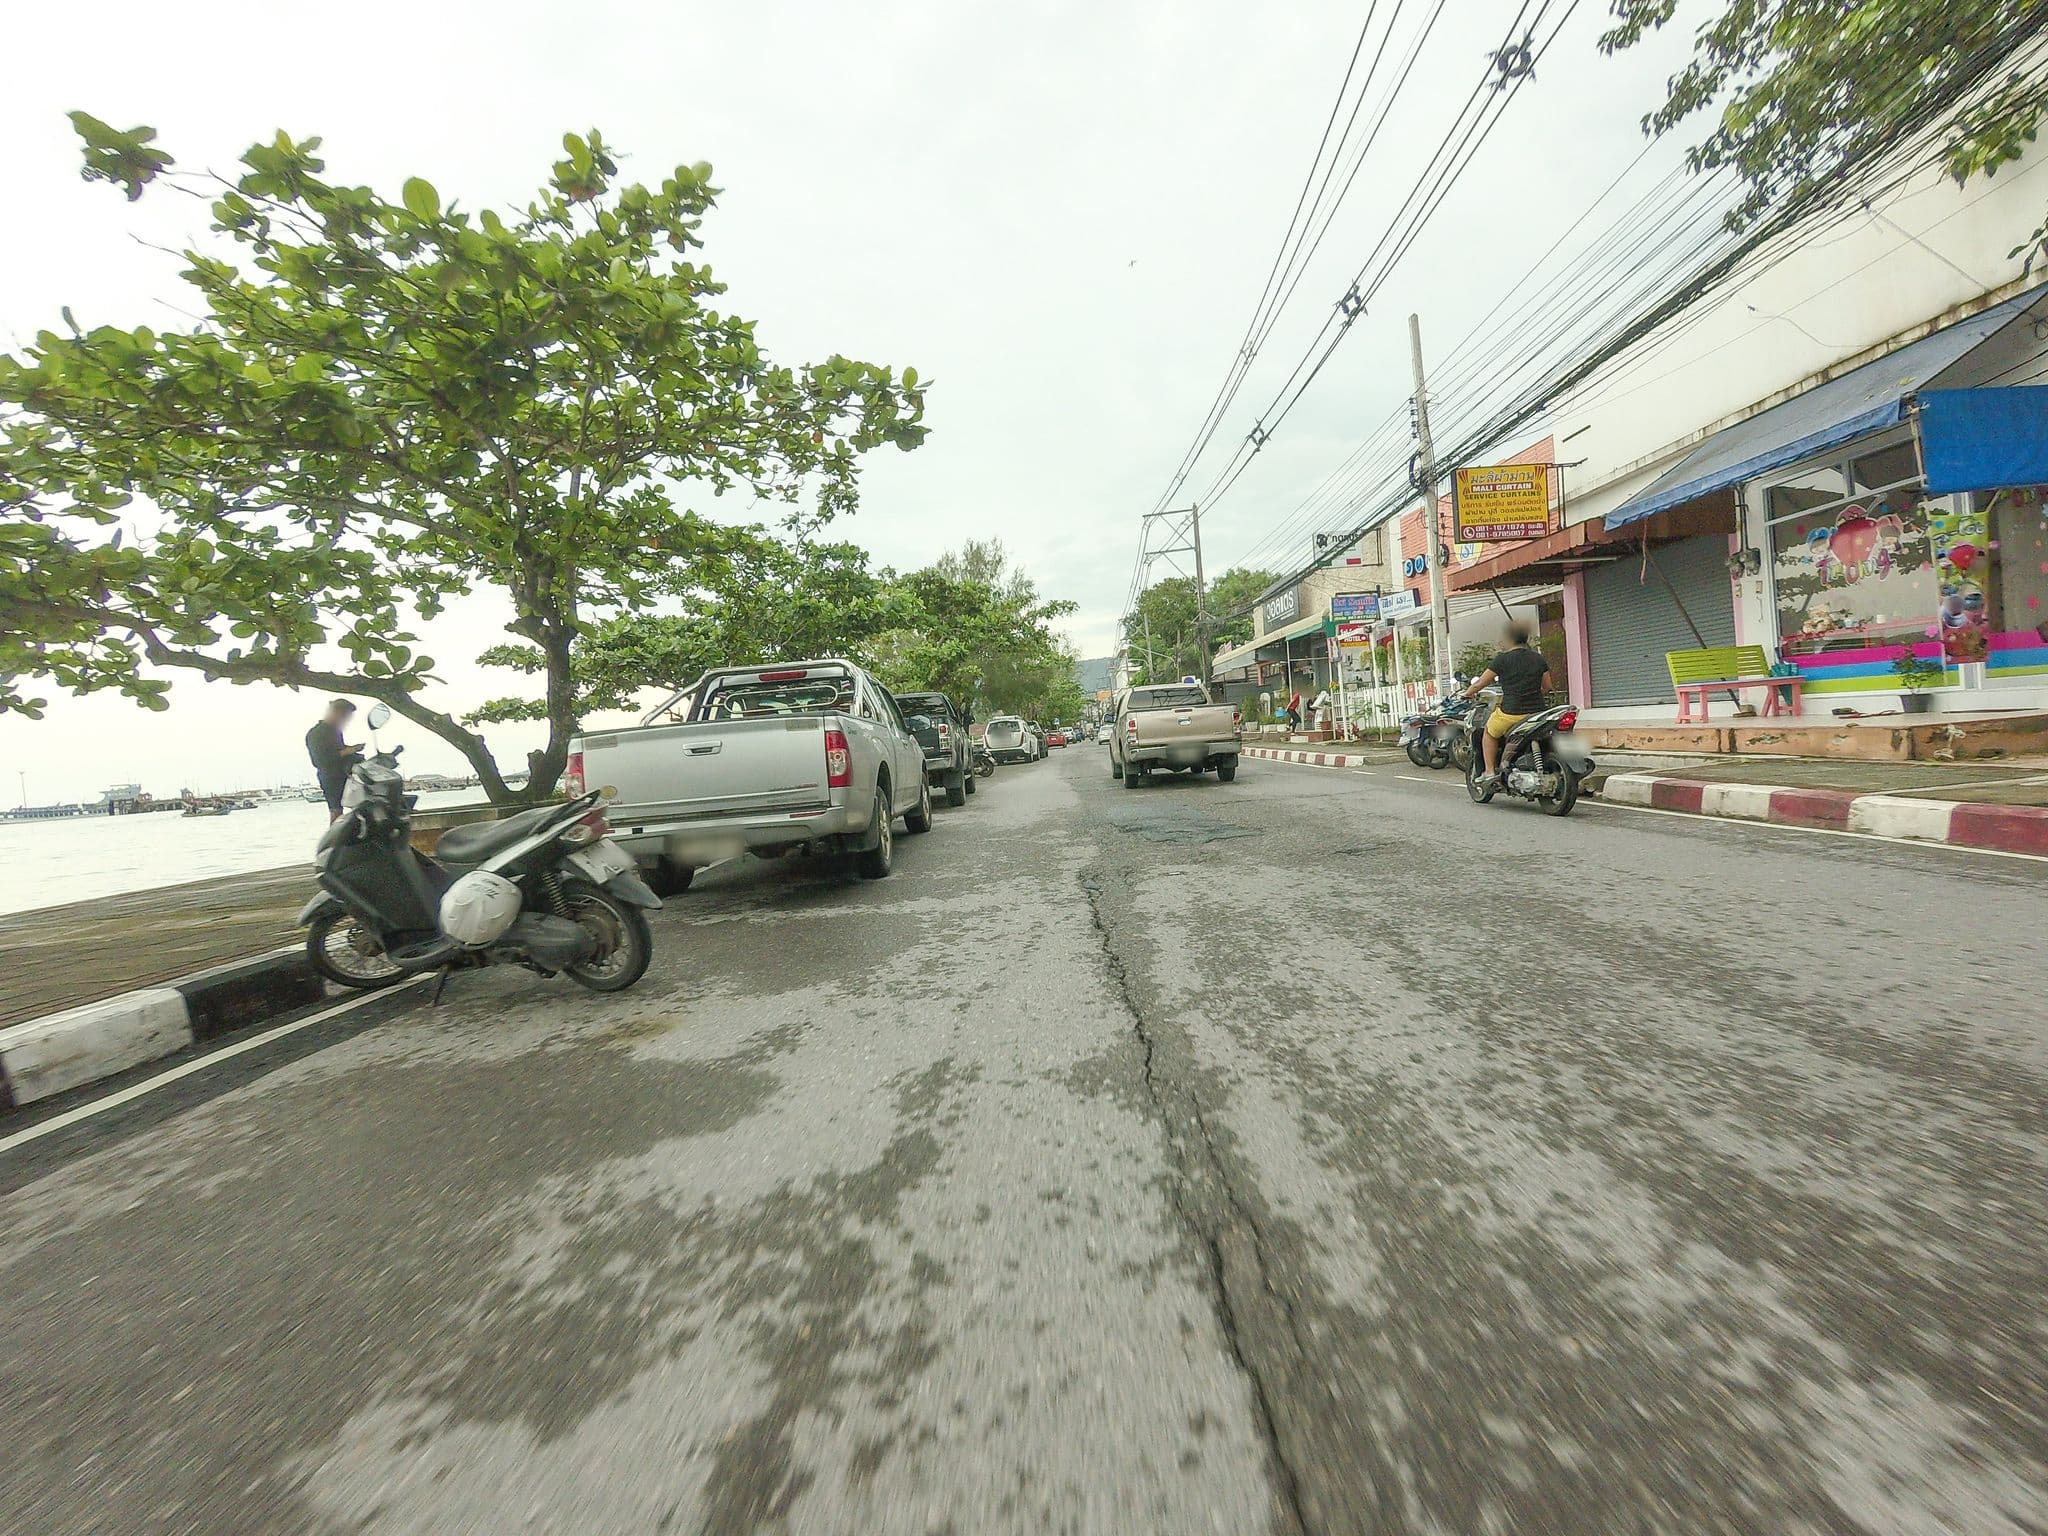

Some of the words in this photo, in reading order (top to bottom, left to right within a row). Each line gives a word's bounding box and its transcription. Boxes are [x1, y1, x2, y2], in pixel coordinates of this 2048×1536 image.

[1472, 484, 1493, 492] MALI
[1496, 483, 1532, 491] CURTAIN
[1501, 490, 1542, 498] CURTAINS
